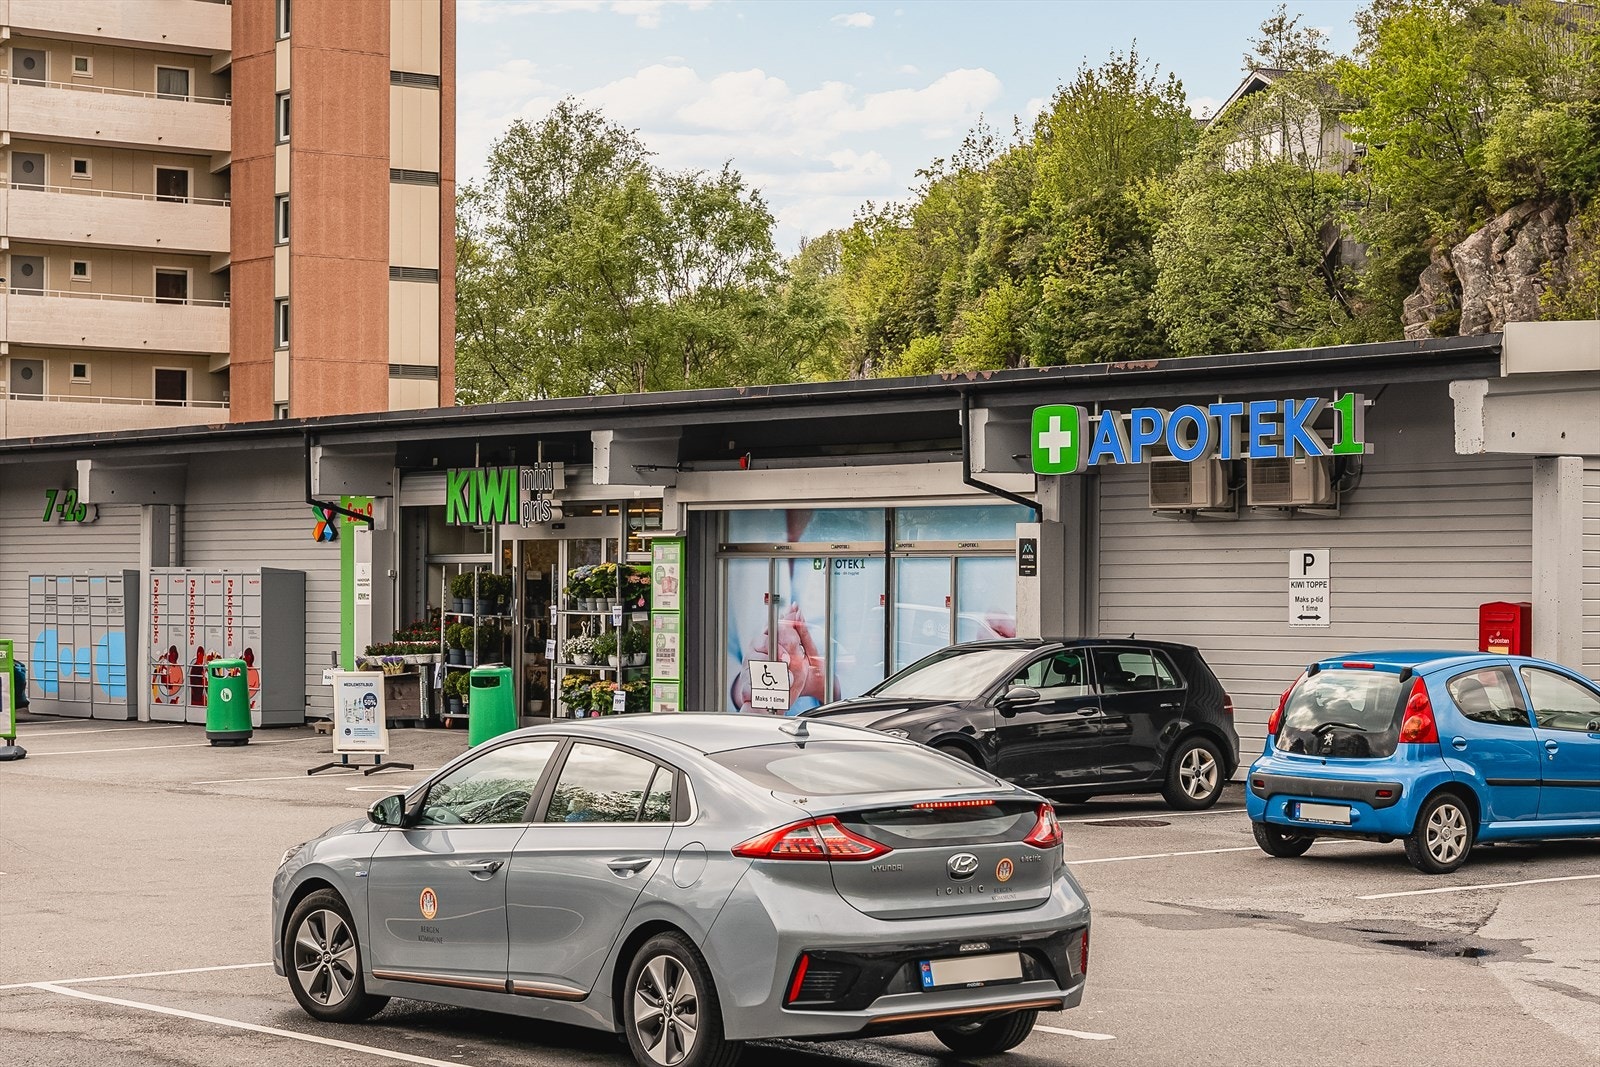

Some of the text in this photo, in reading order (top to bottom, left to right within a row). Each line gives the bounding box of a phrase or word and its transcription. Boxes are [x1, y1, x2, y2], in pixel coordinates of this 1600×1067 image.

[1088, 393, 1364, 465] APOTEK 1
[521, 462, 553, 490] mini
[447, 468, 518, 523] KIWI
[521, 493, 552, 528] pris
[1303, 553, 1315, 575] P
[1310, 596, 1324, 604] p-tid
[871, 863, 904, 872] HYUNDAI
[417, 935, 444, 944] KOMMUNE
[420, 925, 440, 934] BERGEN
